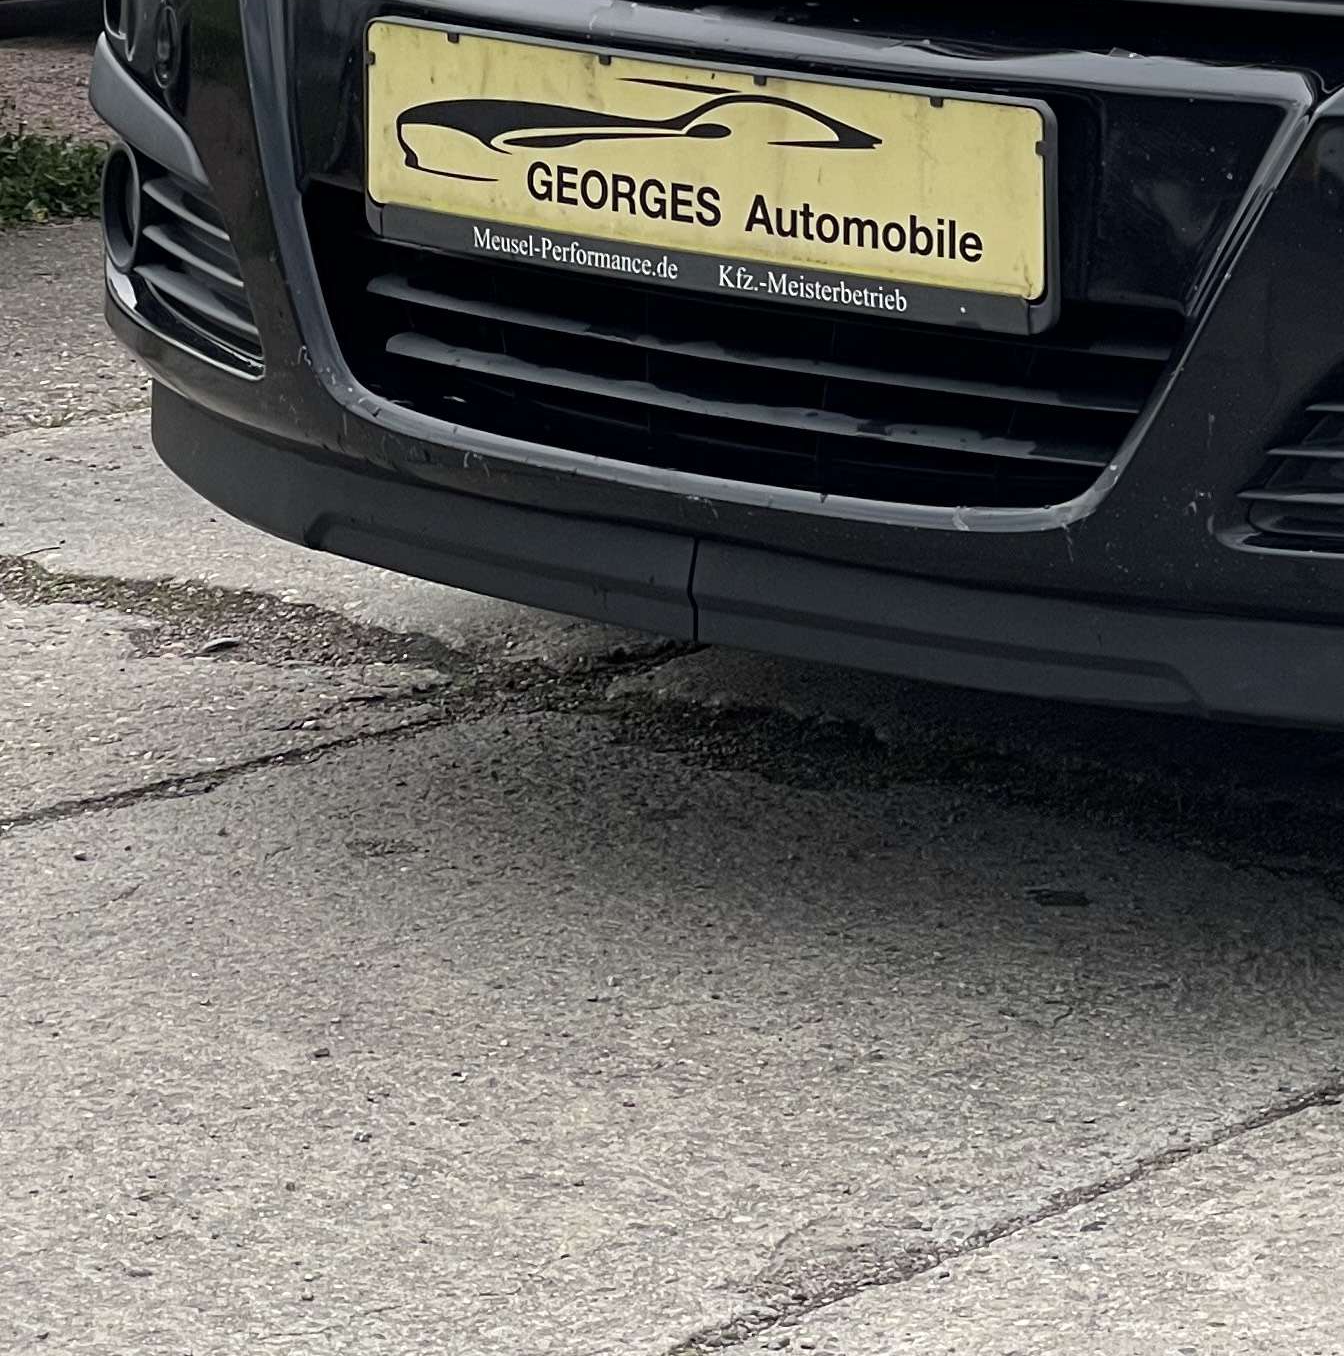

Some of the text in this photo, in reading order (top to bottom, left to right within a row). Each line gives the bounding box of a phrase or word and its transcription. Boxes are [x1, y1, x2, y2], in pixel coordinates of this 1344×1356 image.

[527, 161, 983, 263] GEORGES Automobile
[473, 225, 908, 312] Meusel-Performance.de Kfz.-Meisterbetrieb
